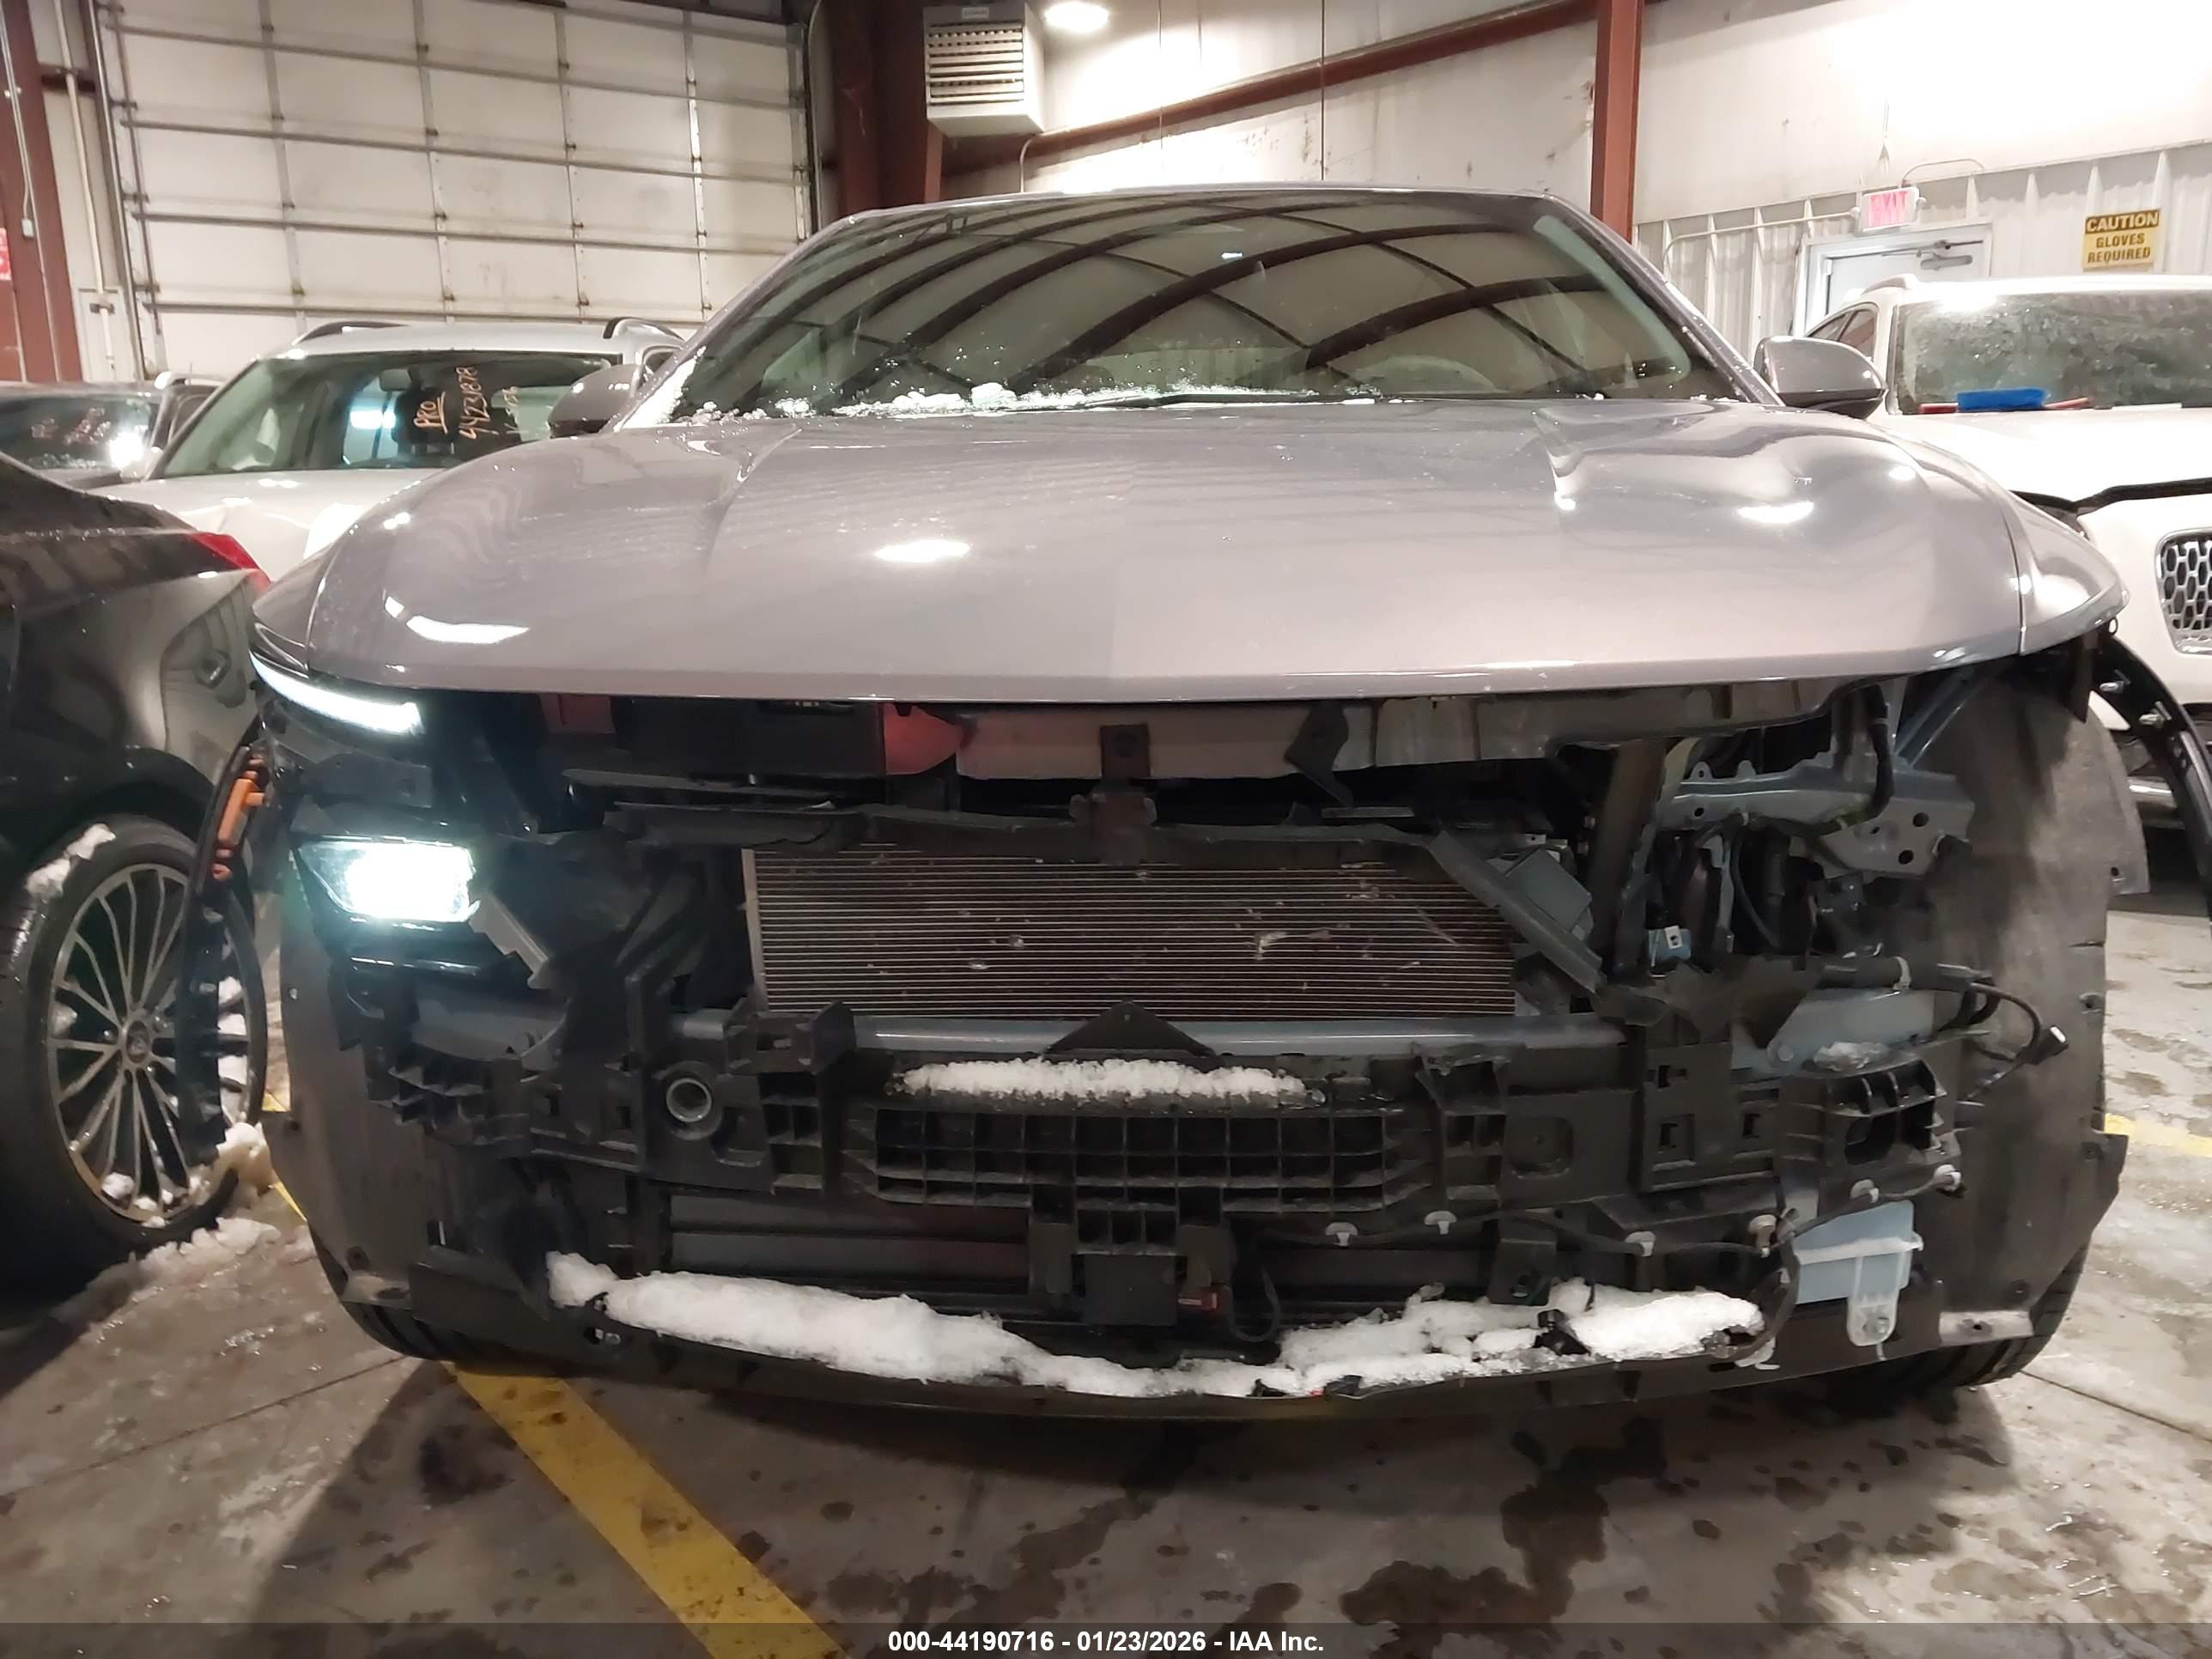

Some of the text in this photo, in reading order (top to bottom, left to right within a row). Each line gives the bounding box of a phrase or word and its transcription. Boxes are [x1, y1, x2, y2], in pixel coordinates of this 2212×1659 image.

[2087, 211, 2159, 233] CAUTION
[2095, 233, 2145, 248] GLOVES
[2087, 246, 2151, 264] REQUIRED
